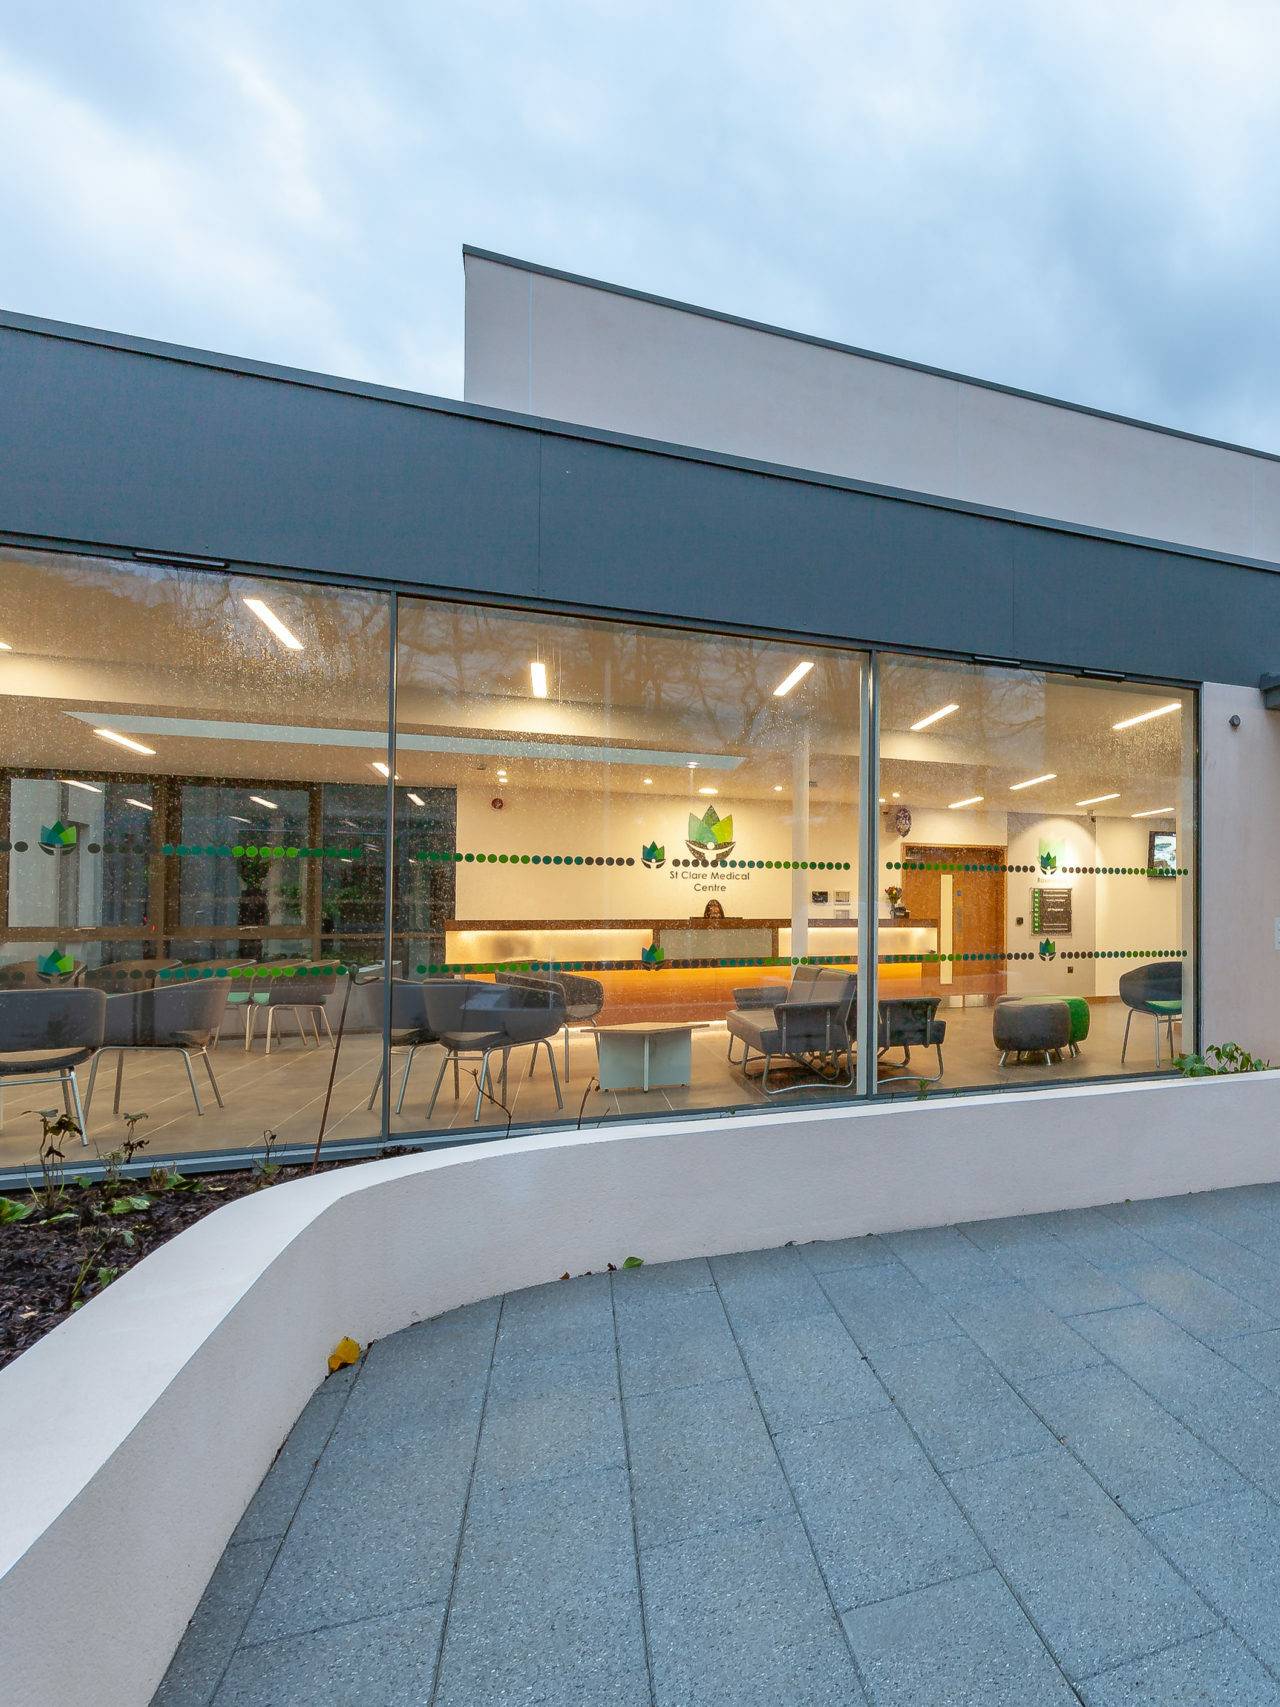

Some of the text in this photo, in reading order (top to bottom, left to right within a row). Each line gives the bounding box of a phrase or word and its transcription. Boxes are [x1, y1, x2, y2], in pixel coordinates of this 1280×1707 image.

[669, 870, 750, 881] St Clare Medical
[693, 883, 727, 892] Centre
